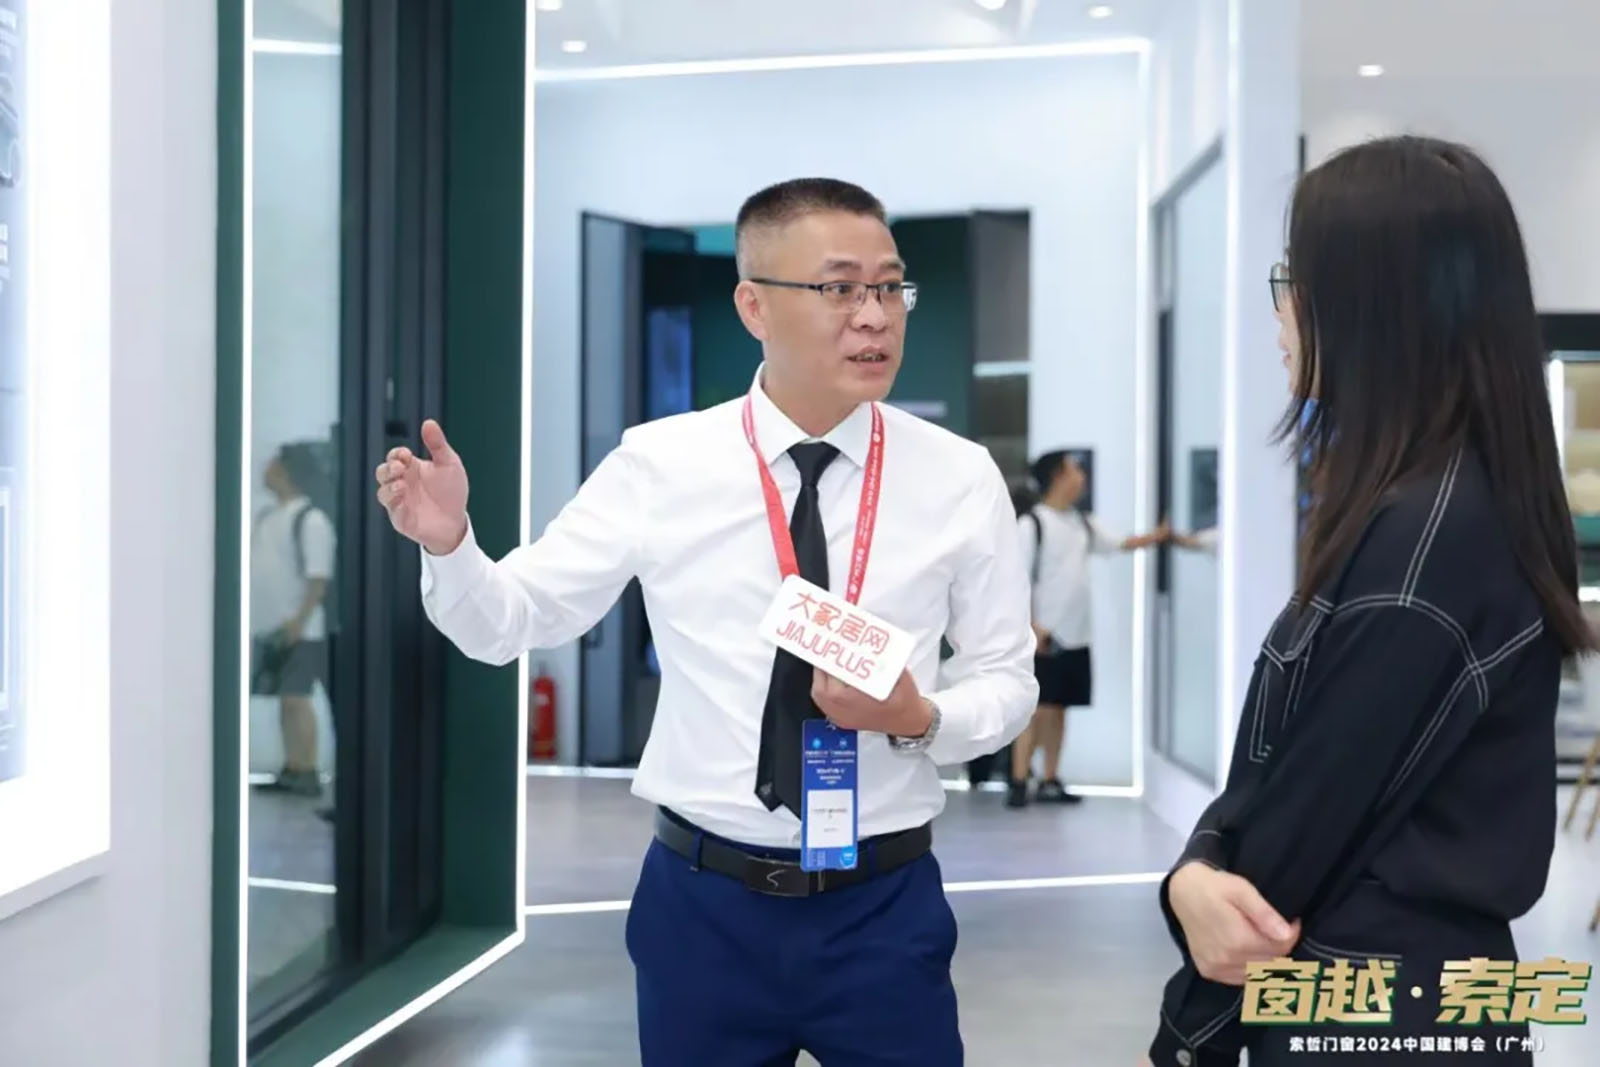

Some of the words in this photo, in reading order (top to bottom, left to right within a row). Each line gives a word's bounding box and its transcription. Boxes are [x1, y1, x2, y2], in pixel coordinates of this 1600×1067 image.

[775, 619, 876, 680] JIAJUPLUS
[788, 592, 890, 655] 大家居网
